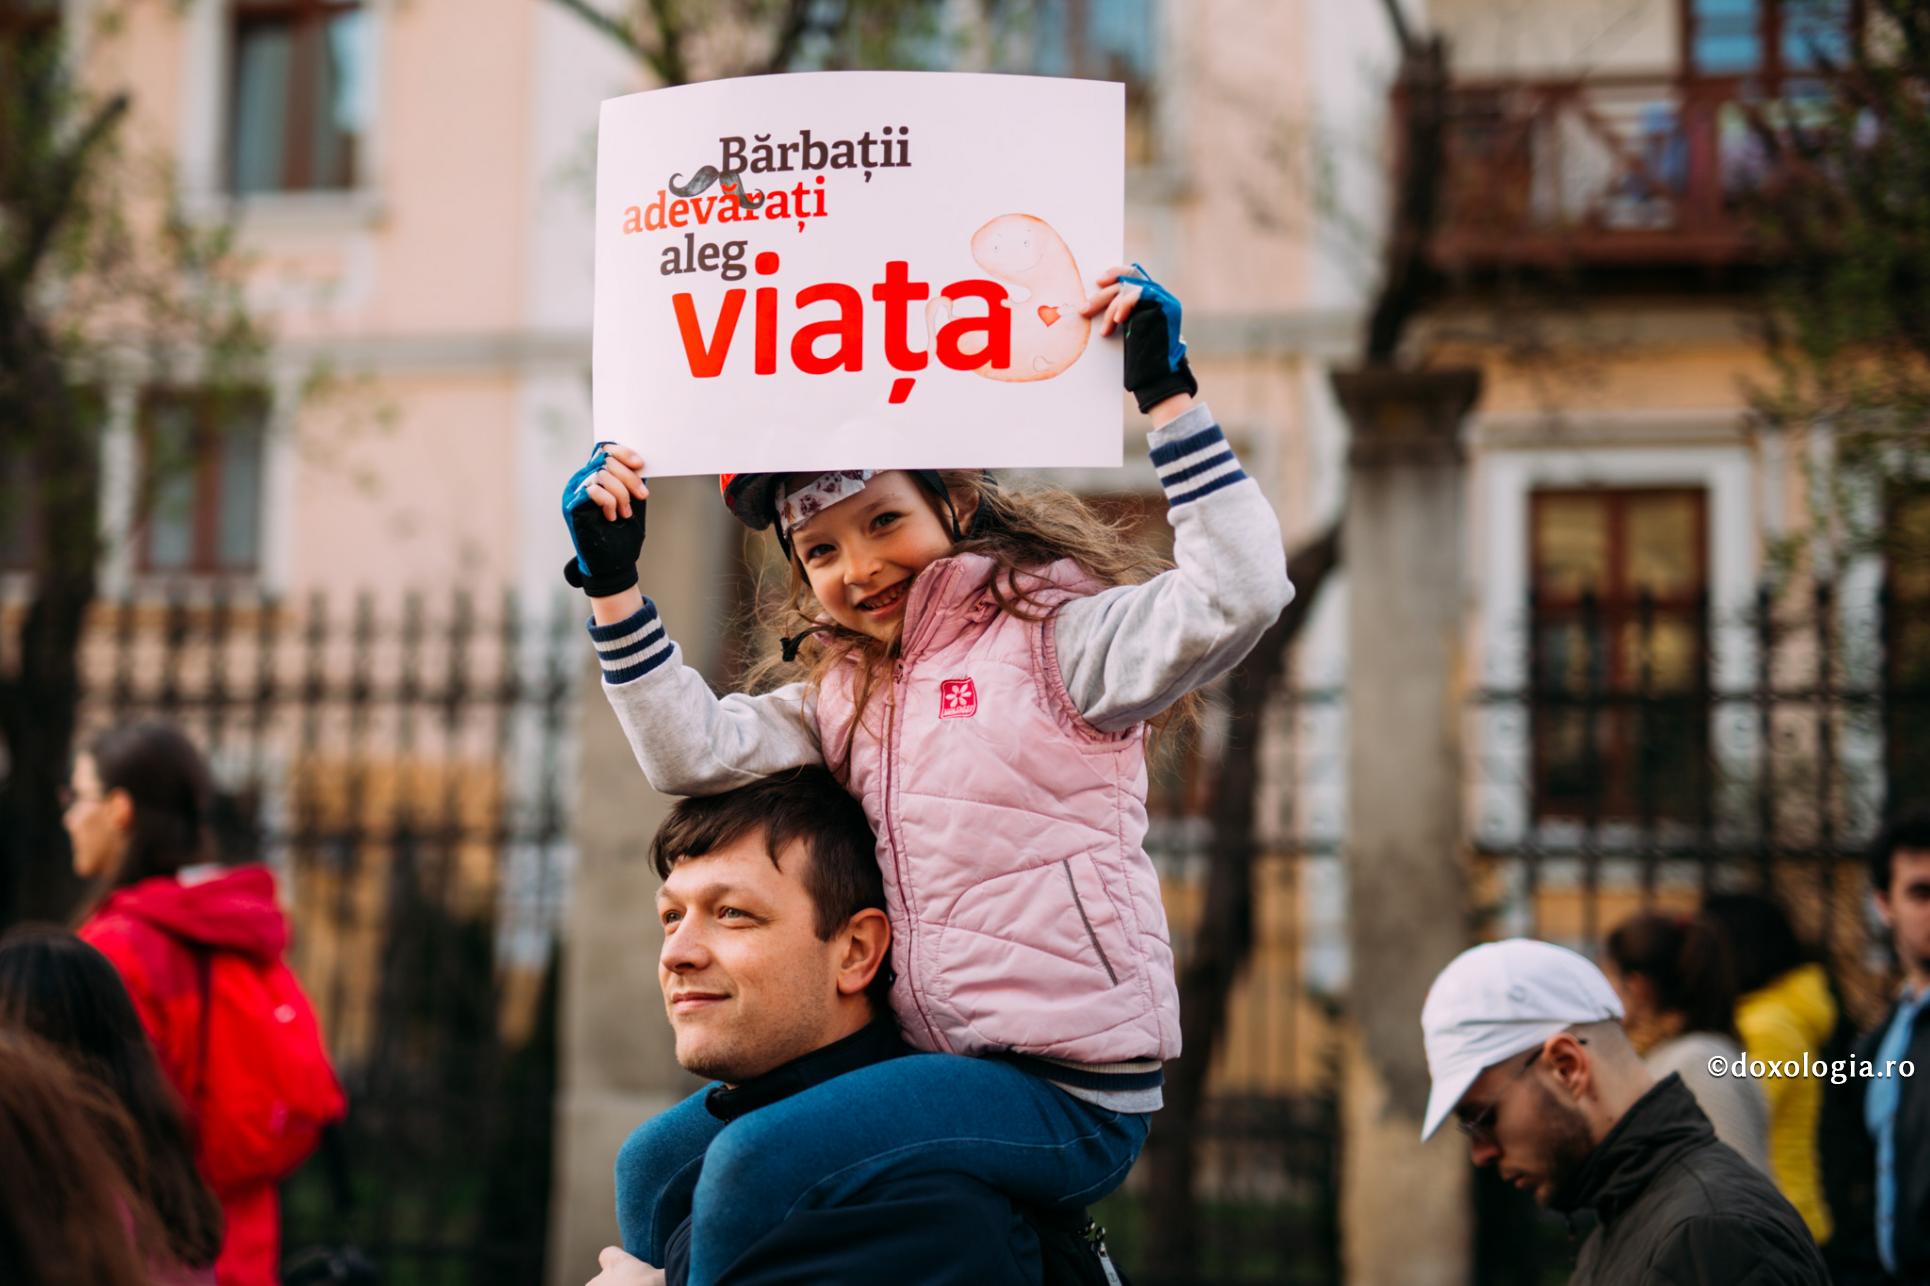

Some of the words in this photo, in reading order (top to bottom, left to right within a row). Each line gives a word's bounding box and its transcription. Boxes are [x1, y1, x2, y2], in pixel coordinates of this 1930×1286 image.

[719, 126, 911, 183] Bărbații
[623, 176, 828, 234] adevărați
[659, 233, 748, 281] aleg
[672, 251, 1012, 404] viața
